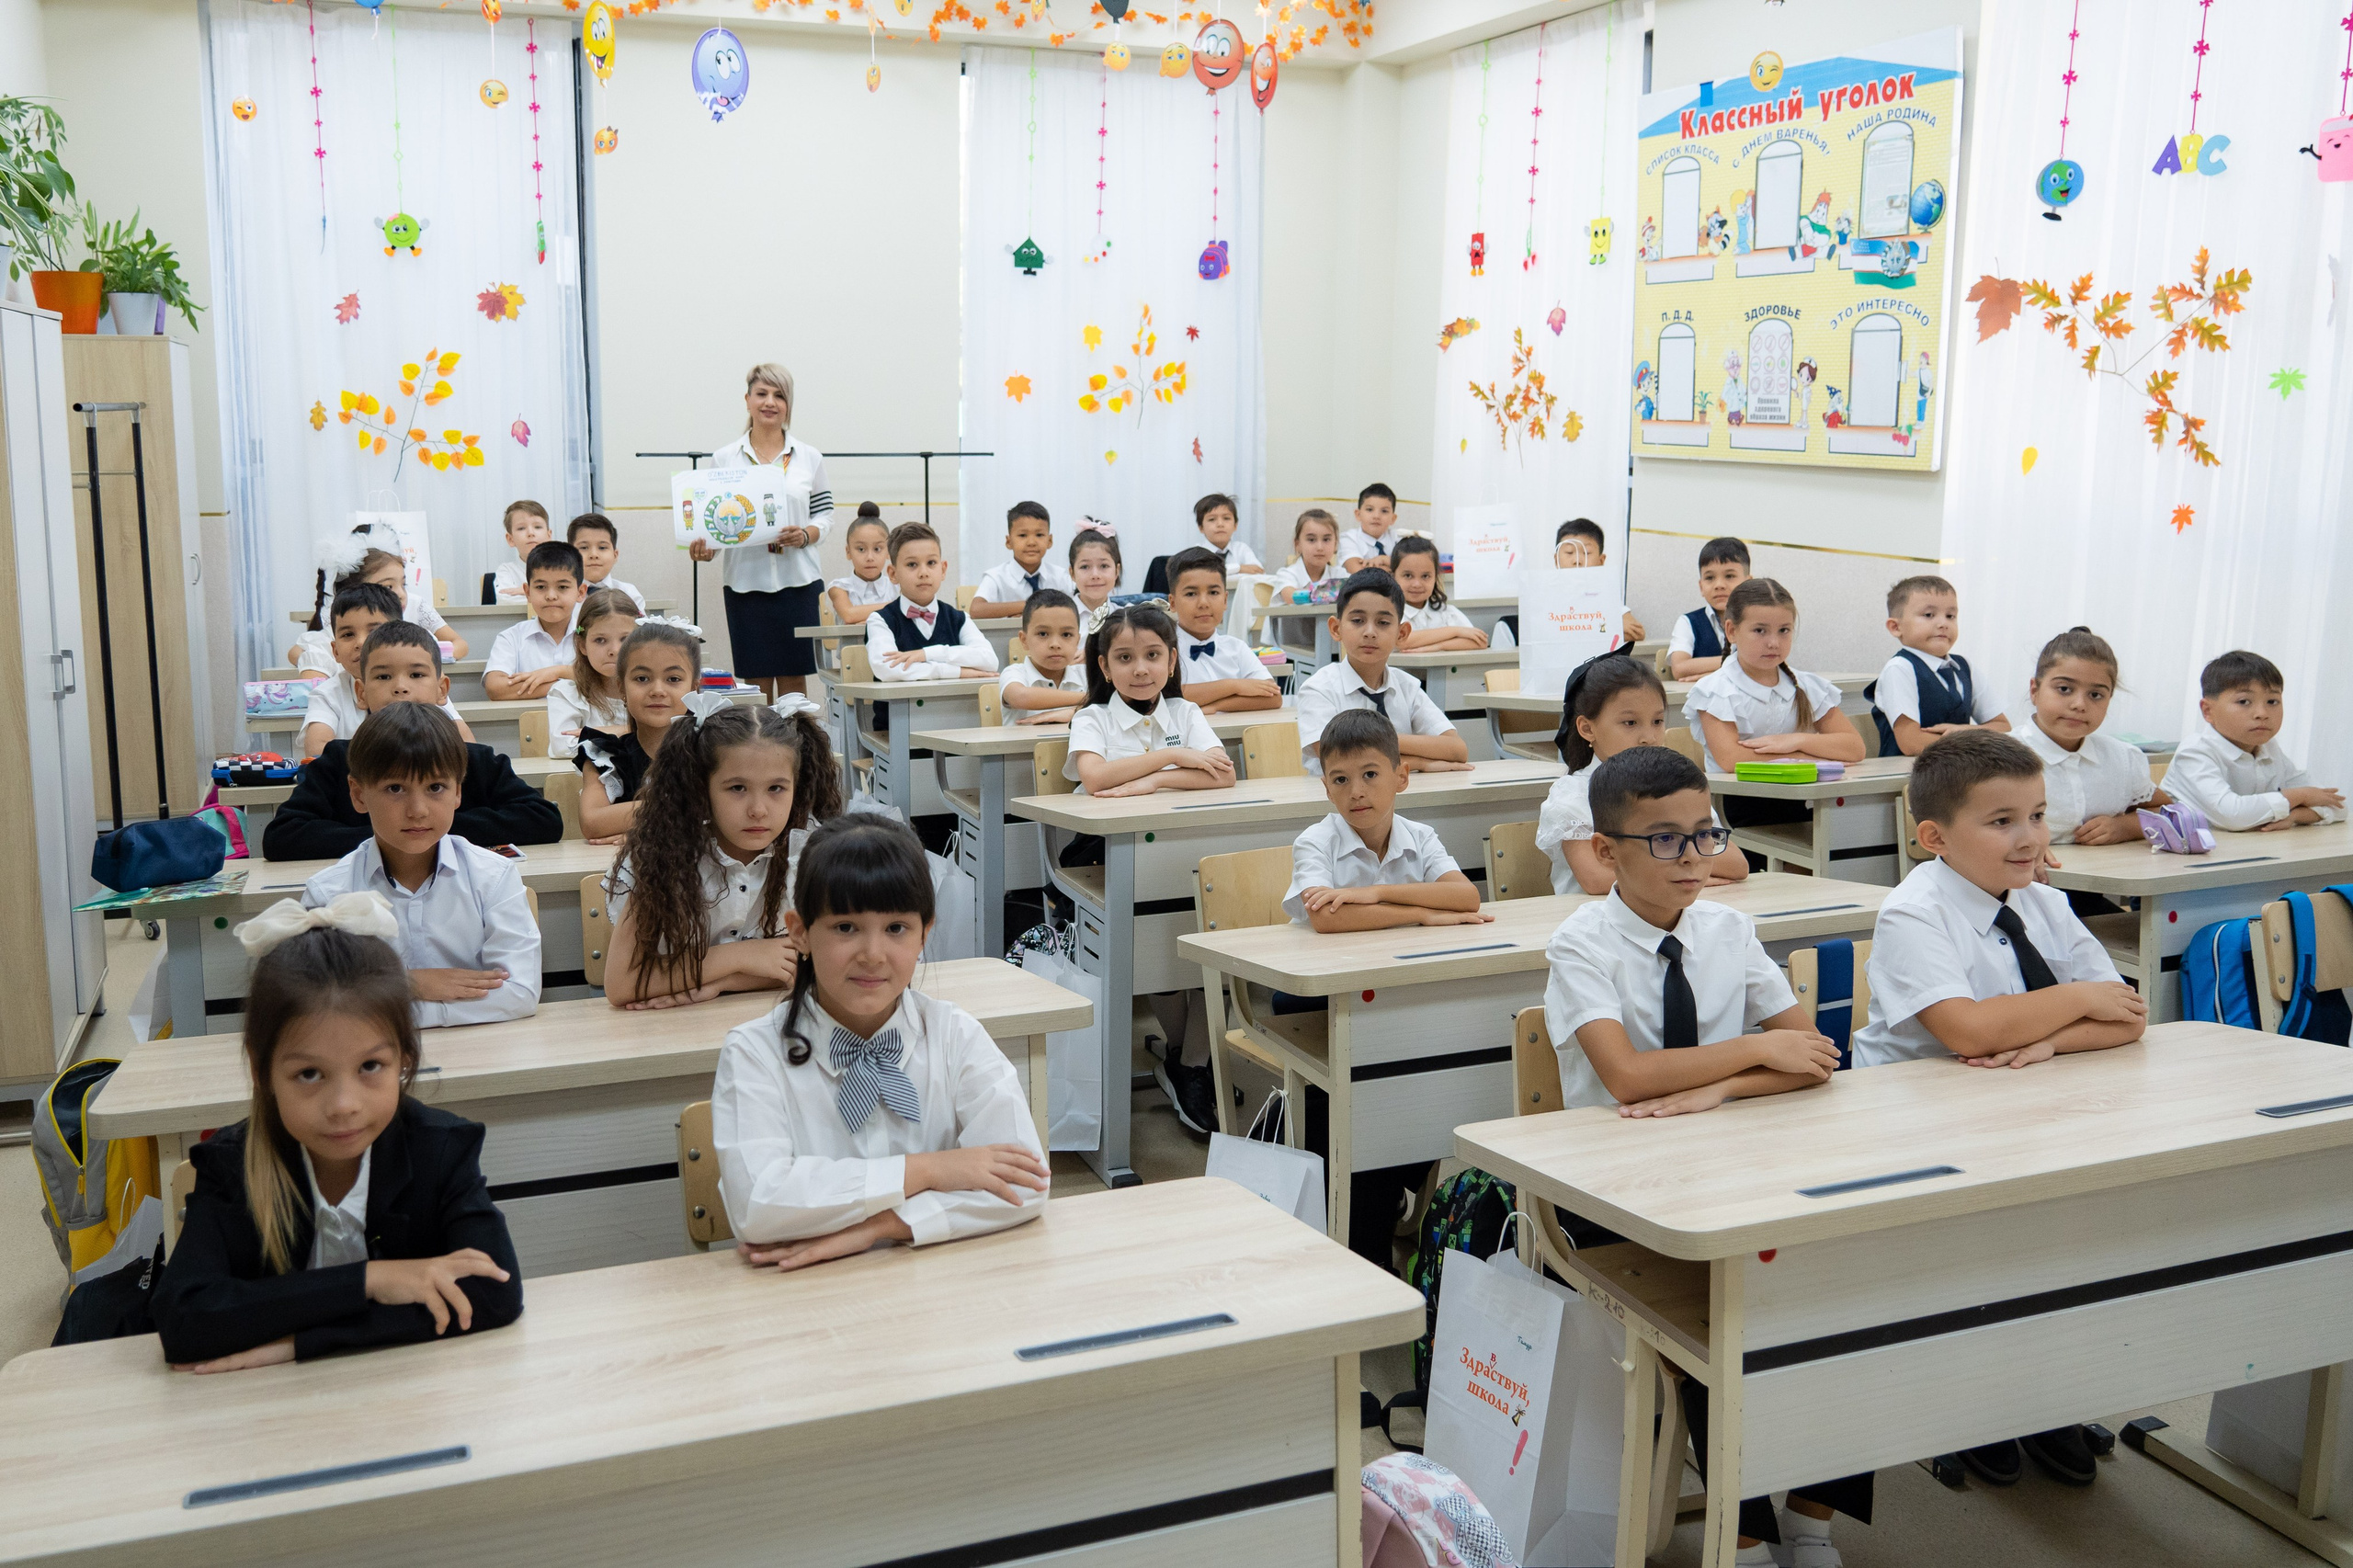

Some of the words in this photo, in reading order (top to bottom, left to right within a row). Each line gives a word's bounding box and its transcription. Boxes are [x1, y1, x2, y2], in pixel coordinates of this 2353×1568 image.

[1681, 89, 1802, 140] Классный
[1820, 74, 1915, 121] уголок
[1847, 112, 1882, 141] НАША
[1887, 108, 1937, 128] РОДИНА
[1646, 146, 1682, 176] СПИСОК
[1685, 144, 1720, 165] КЛАССА
[1742, 131, 1773, 158] ДНЕМ
[1745, 304, 1802, 322] ЗДОРОВЬЕ
[1830, 307, 1853, 330] ЭТО
[1857, 299, 1929, 326] ИНТЕРЕСНО
[1548, 610, 1606, 622] Здраствуй,
[1460, 1346, 1529, 1408] Здраствуй,
[1466, 1380, 1509, 1415] школа
